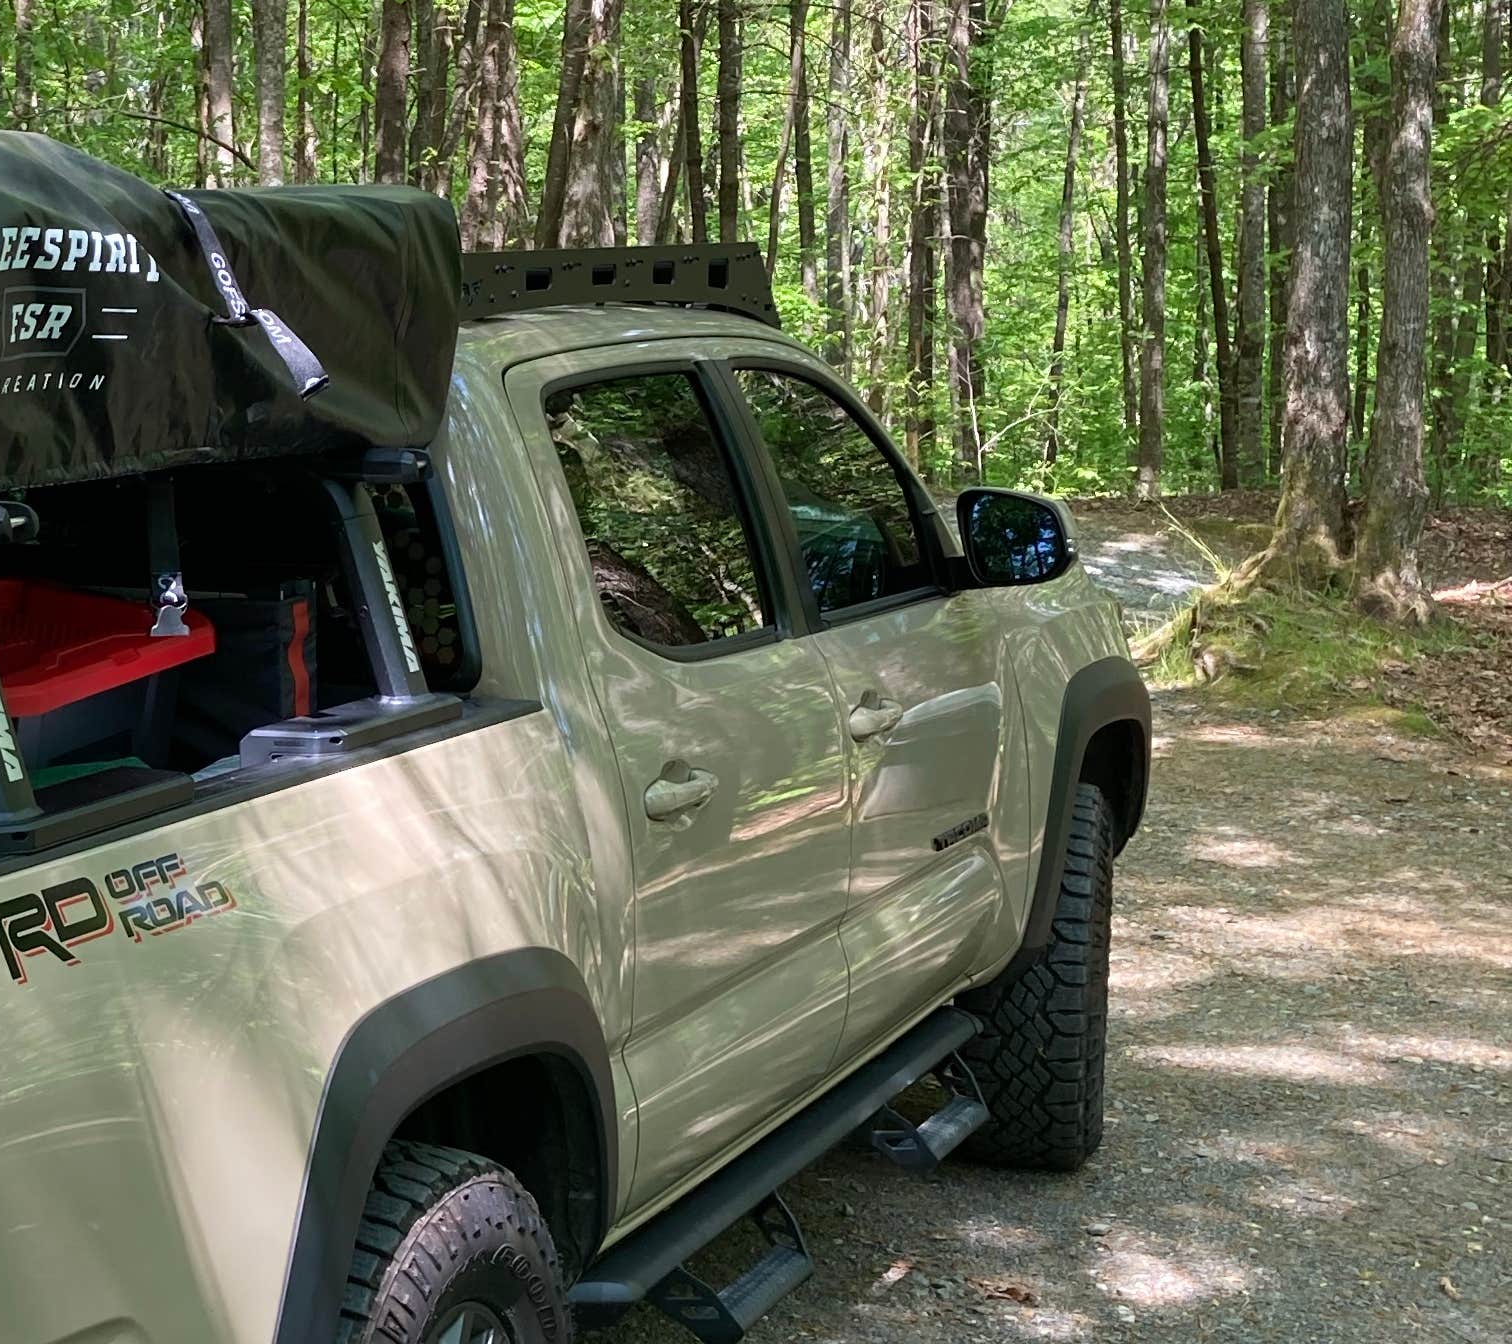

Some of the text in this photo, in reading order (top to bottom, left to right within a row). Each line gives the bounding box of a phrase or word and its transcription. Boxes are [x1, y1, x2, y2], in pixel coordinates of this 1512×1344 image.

[210, 252, 246, 321] GOFS
[9, 304, 73, 343] FSR
[372, 540, 420, 673] YAKIMA
[105, 853, 187, 904] OFF
[118, 880, 237, 943] ROAD
